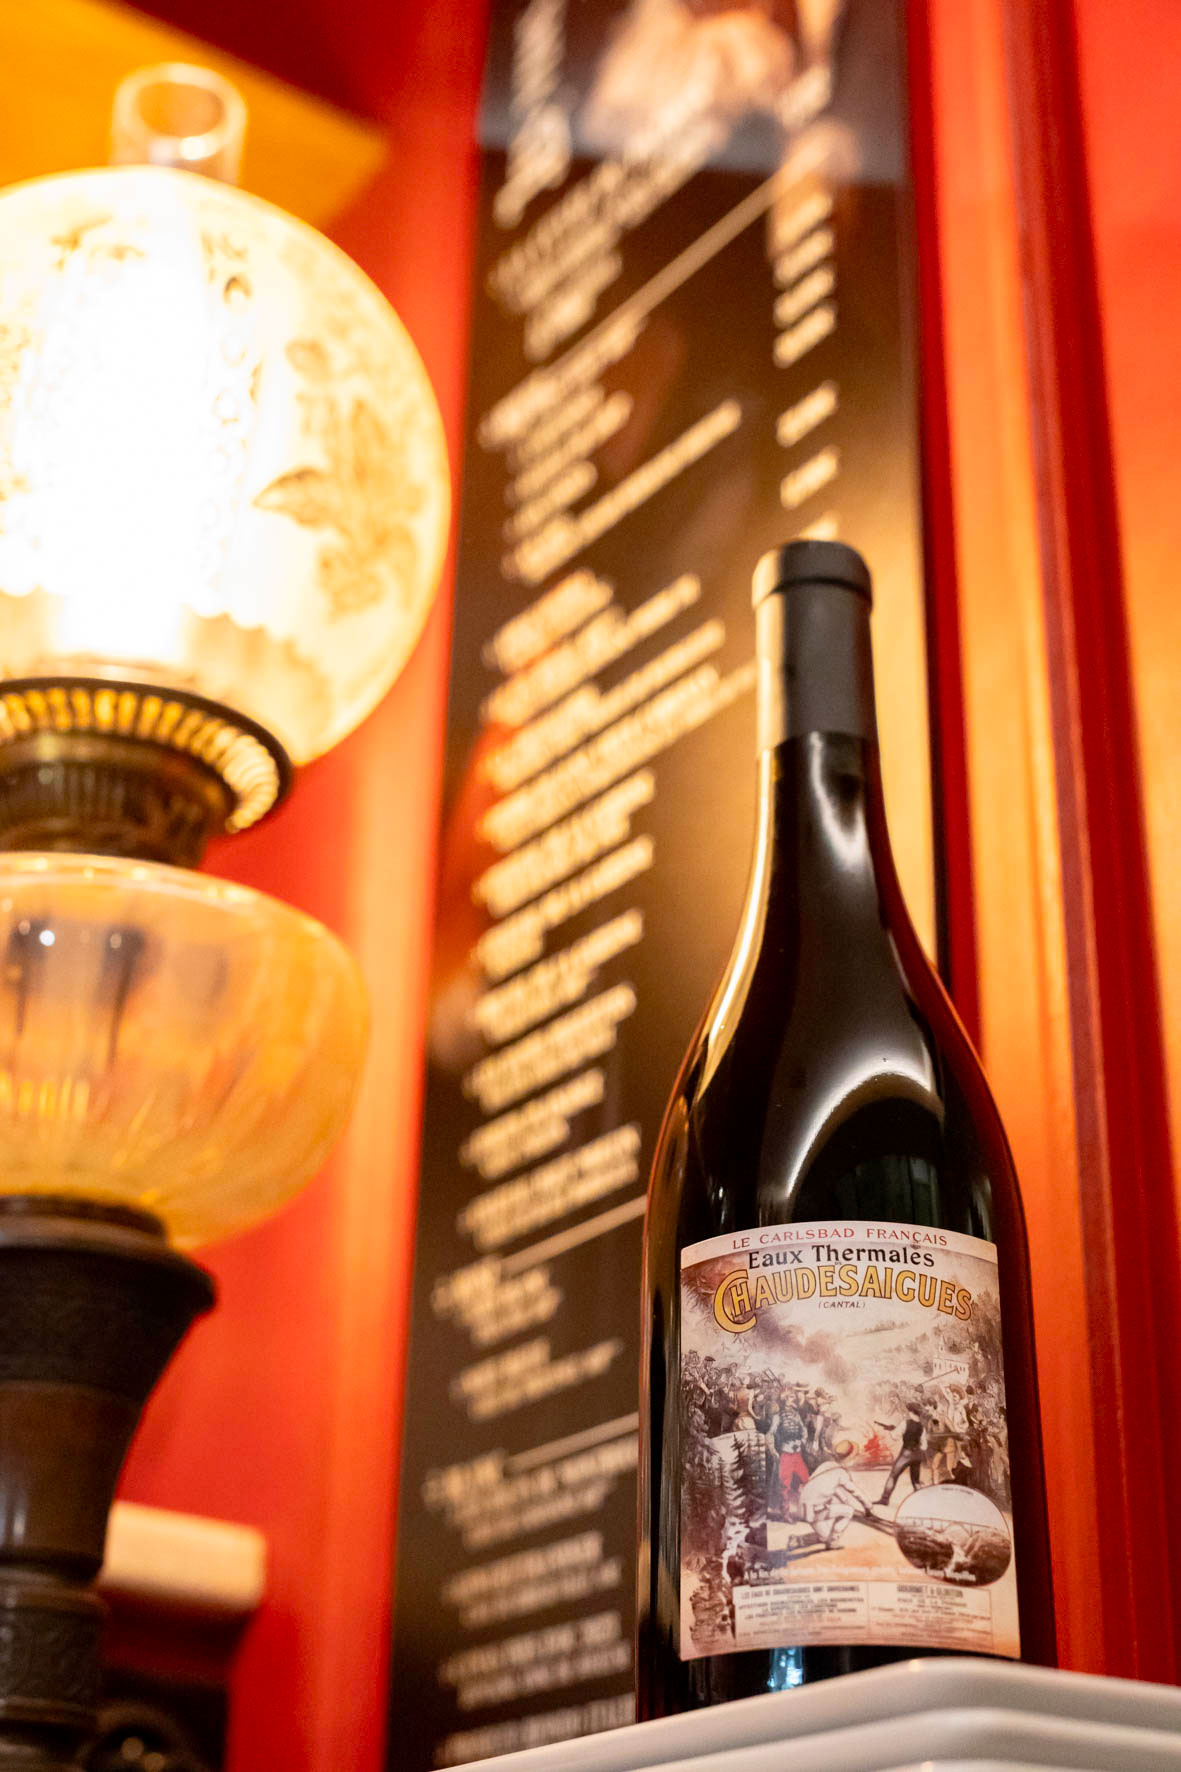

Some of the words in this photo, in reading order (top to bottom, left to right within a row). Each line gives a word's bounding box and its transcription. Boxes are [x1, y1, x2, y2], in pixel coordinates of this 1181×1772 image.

[733, 1237, 750, 1249] LE
[759, 1228, 855, 1244] CARLSBAD
[866, 1228, 948, 1246] FRANÇAIS
[748, 1251, 803, 1270] Eaux
[811, 1244, 936, 1268] Thermales
[713, 1264, 973, 1333] CHAUDESAIGUES
